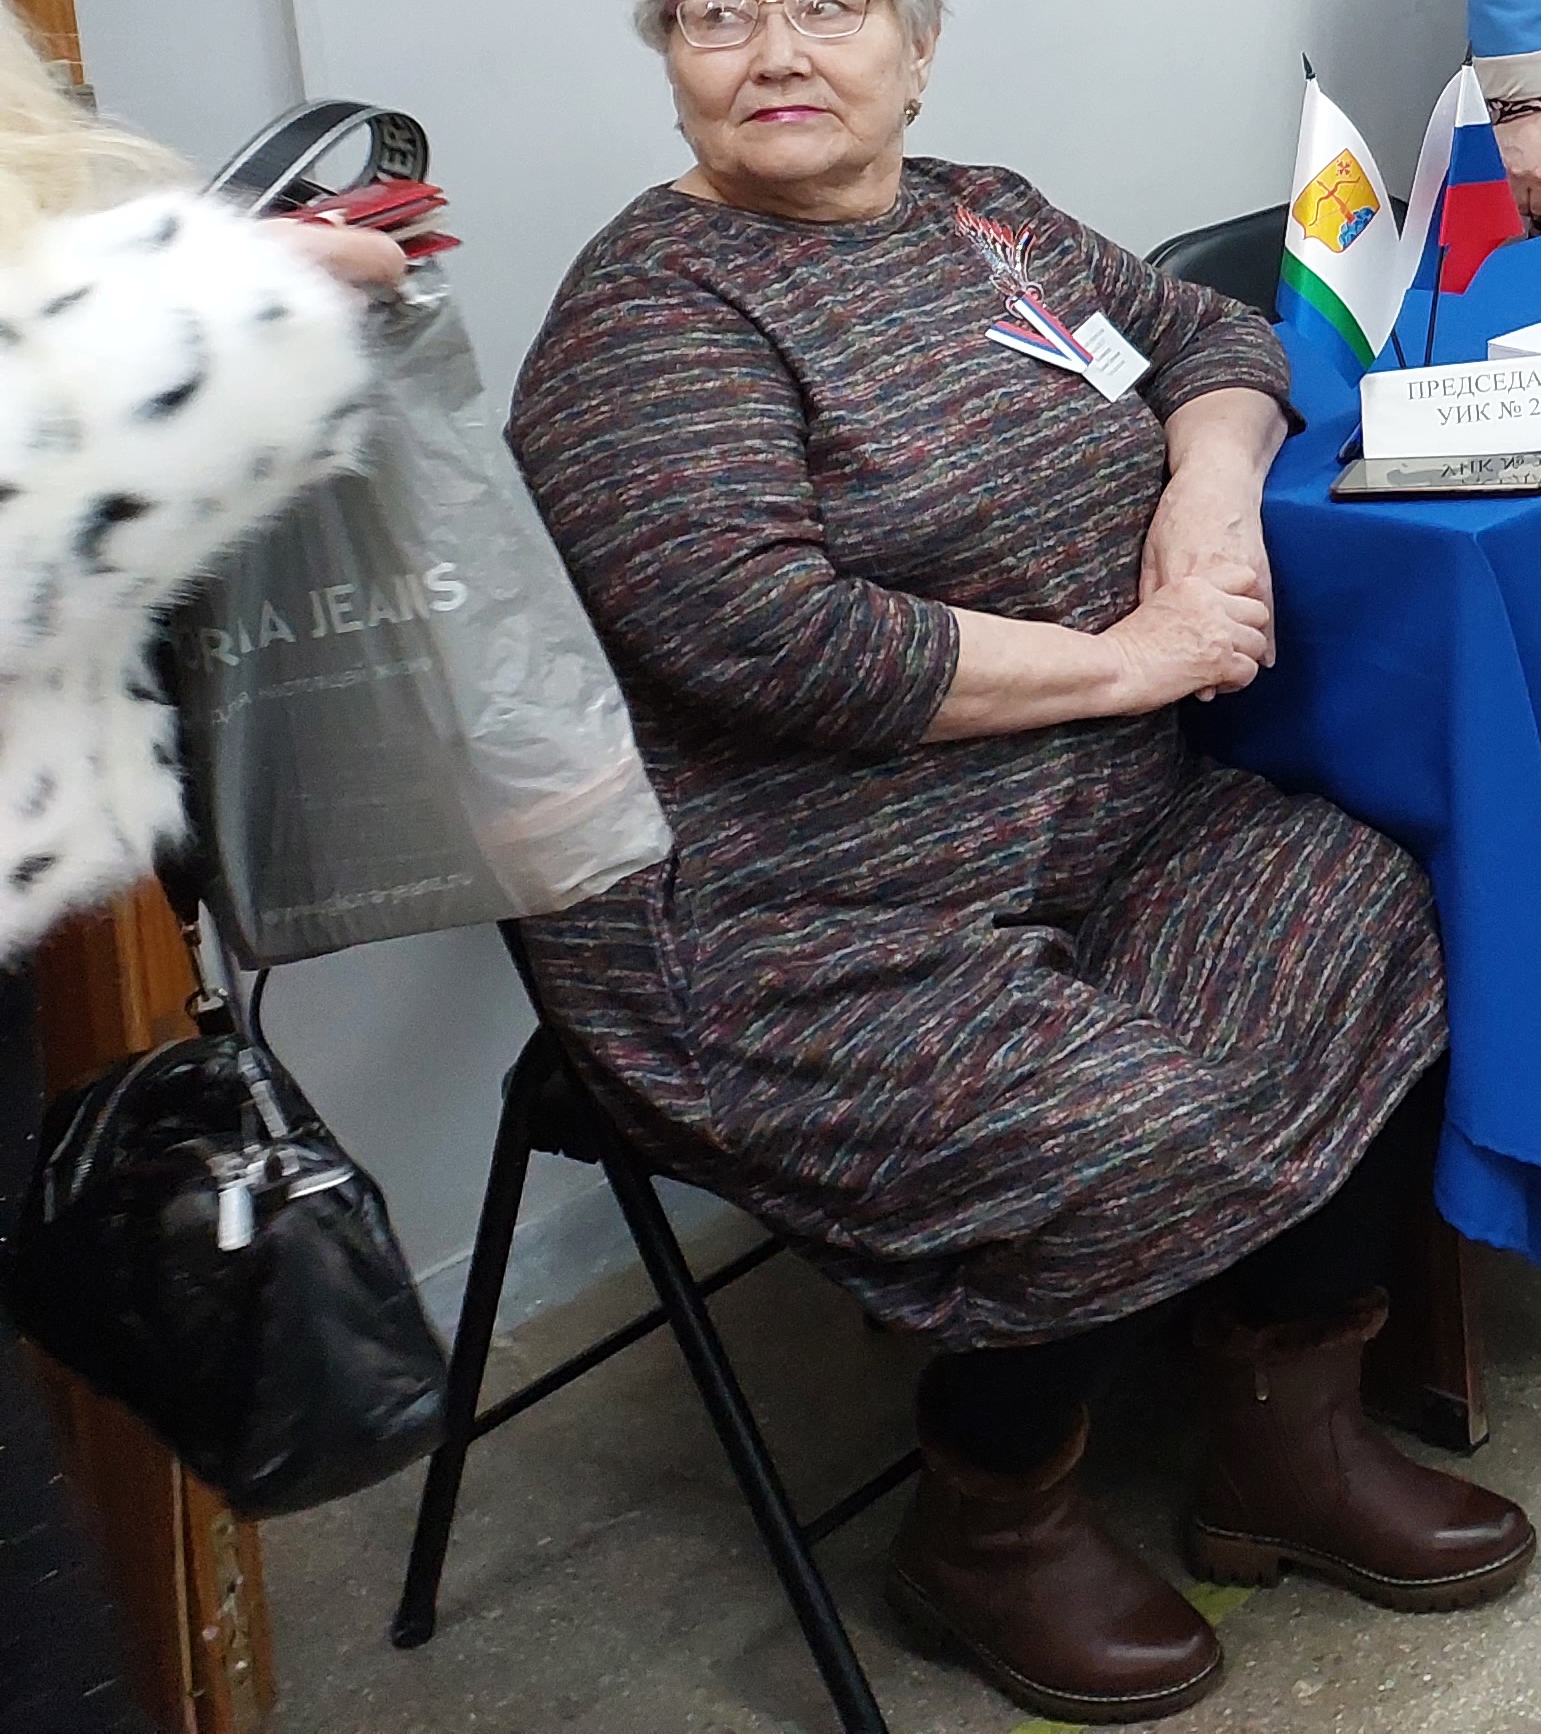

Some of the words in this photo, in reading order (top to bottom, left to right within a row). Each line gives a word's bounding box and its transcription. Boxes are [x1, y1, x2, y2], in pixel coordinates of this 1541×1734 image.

[1437, 402, 1490, 426] УИК
[1498, 400, 1522, 419] №
[309, 562, 467, 639] JEANS
